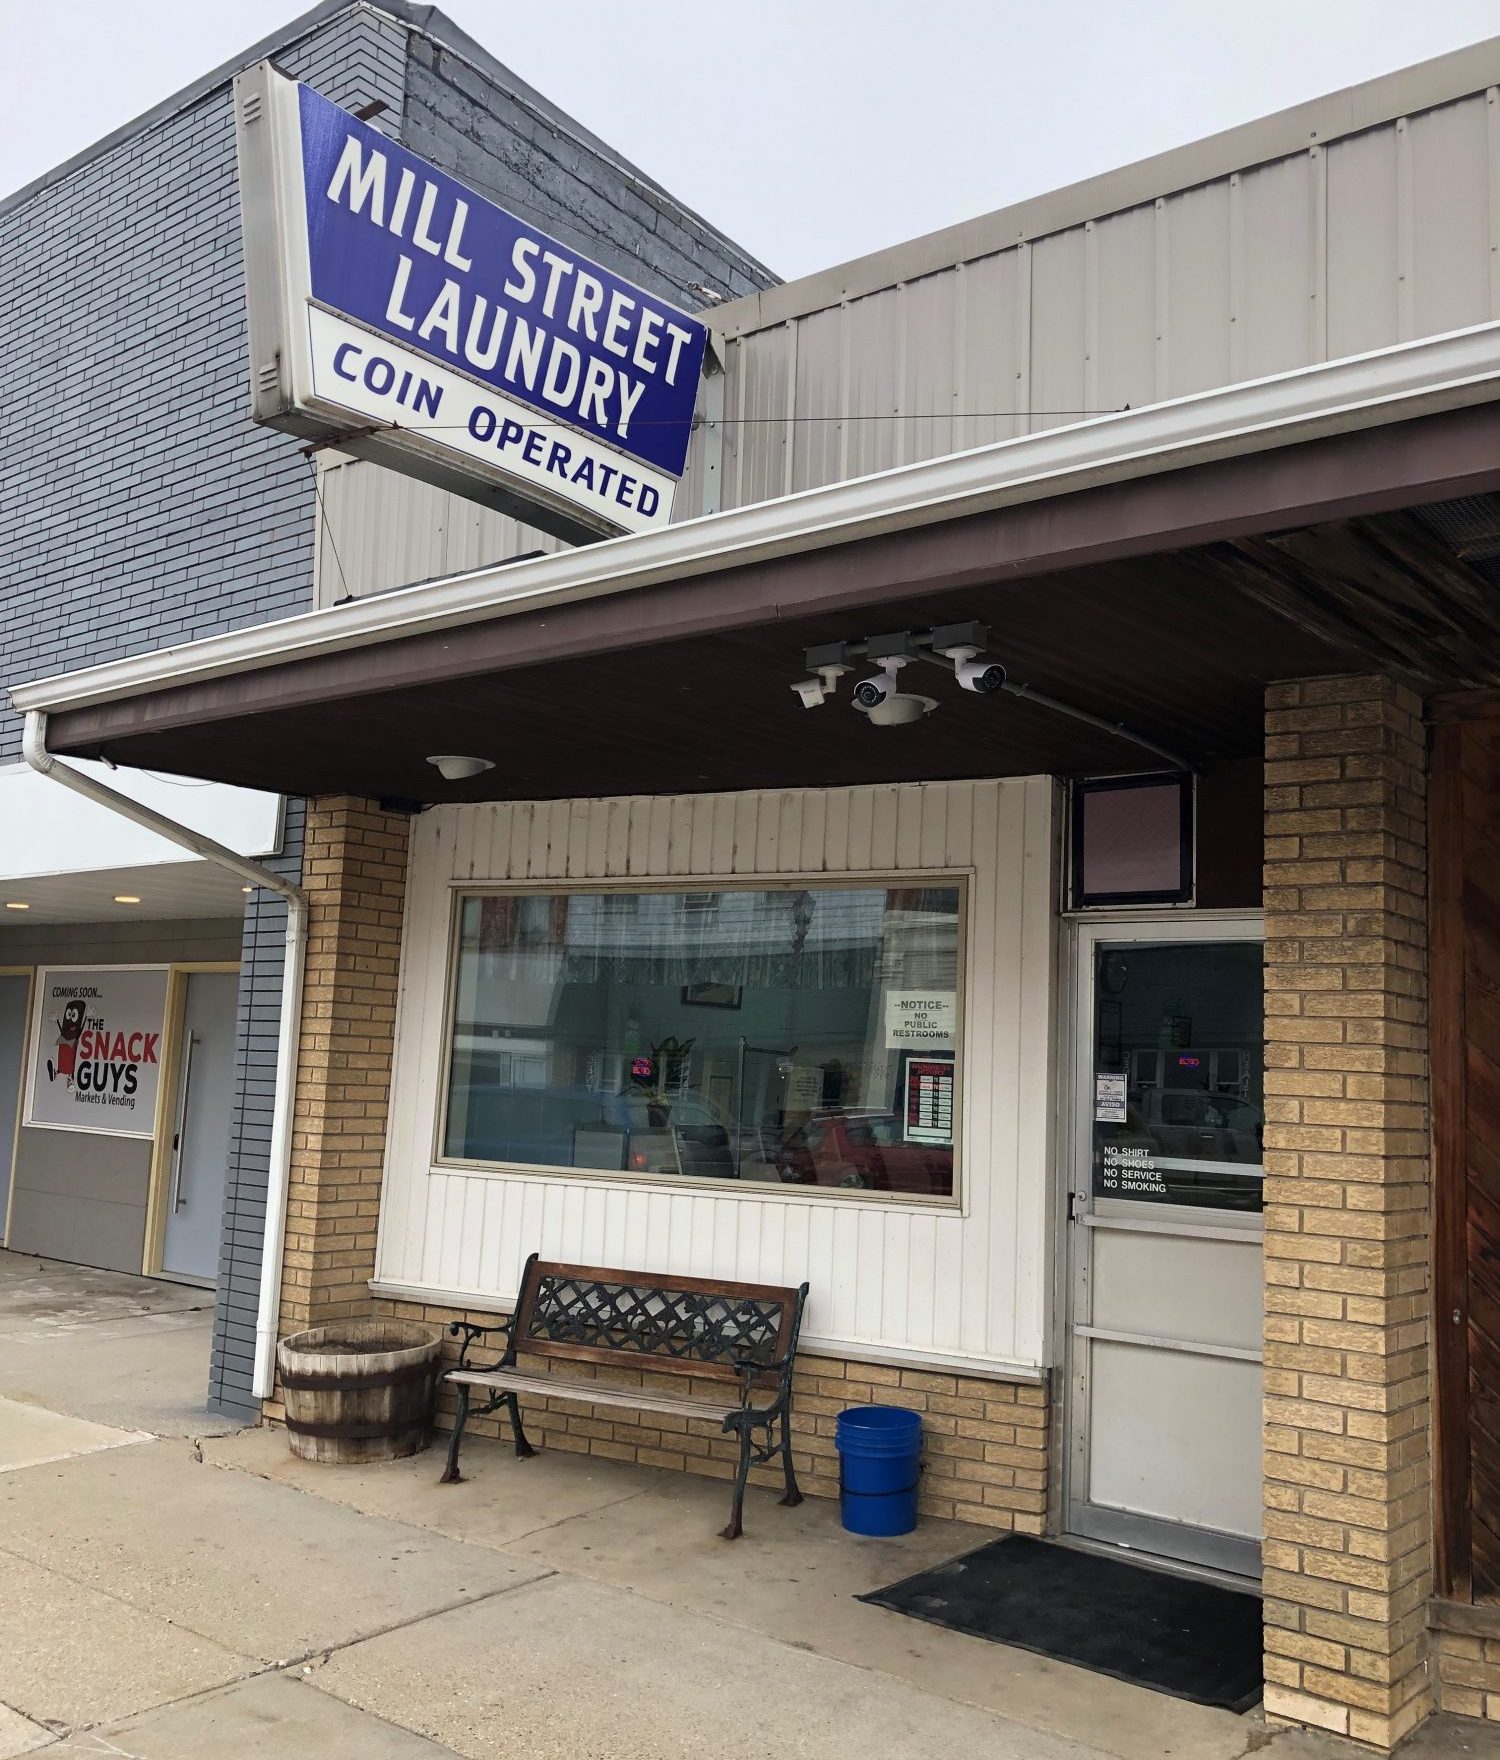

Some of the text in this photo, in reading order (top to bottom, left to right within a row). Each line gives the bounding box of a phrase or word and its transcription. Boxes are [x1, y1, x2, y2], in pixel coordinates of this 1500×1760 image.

[326, 134, 692, 387] MILL STREET
[385, 255, 646, 440] LAUNDRY
[333, 341, 660, 518] COIN OPERATED
[52, 986, 78, 998] COMING
[914, 1012, 928, 1020] NO
[87, 1018, 104, 1031] THE
[904, 1020, 938, 1029] PUBLIC
[892, 1029, 949, 1039] RESTROOMS
[79, 1030, 160, 1064] SNACK
[76, 1060, 138, 1095] GUYS
[74, 1091, 136, 1110] Markets & Vending
[1104, 1146, 1150, 1158] NO SHIRT
[1104, 1157, 1155, 1170] NO SHOES
[1103, 1168, 1162, 1182] NO SERVICE
[1103, 1179, 1167, 1193] NO SMOKING
